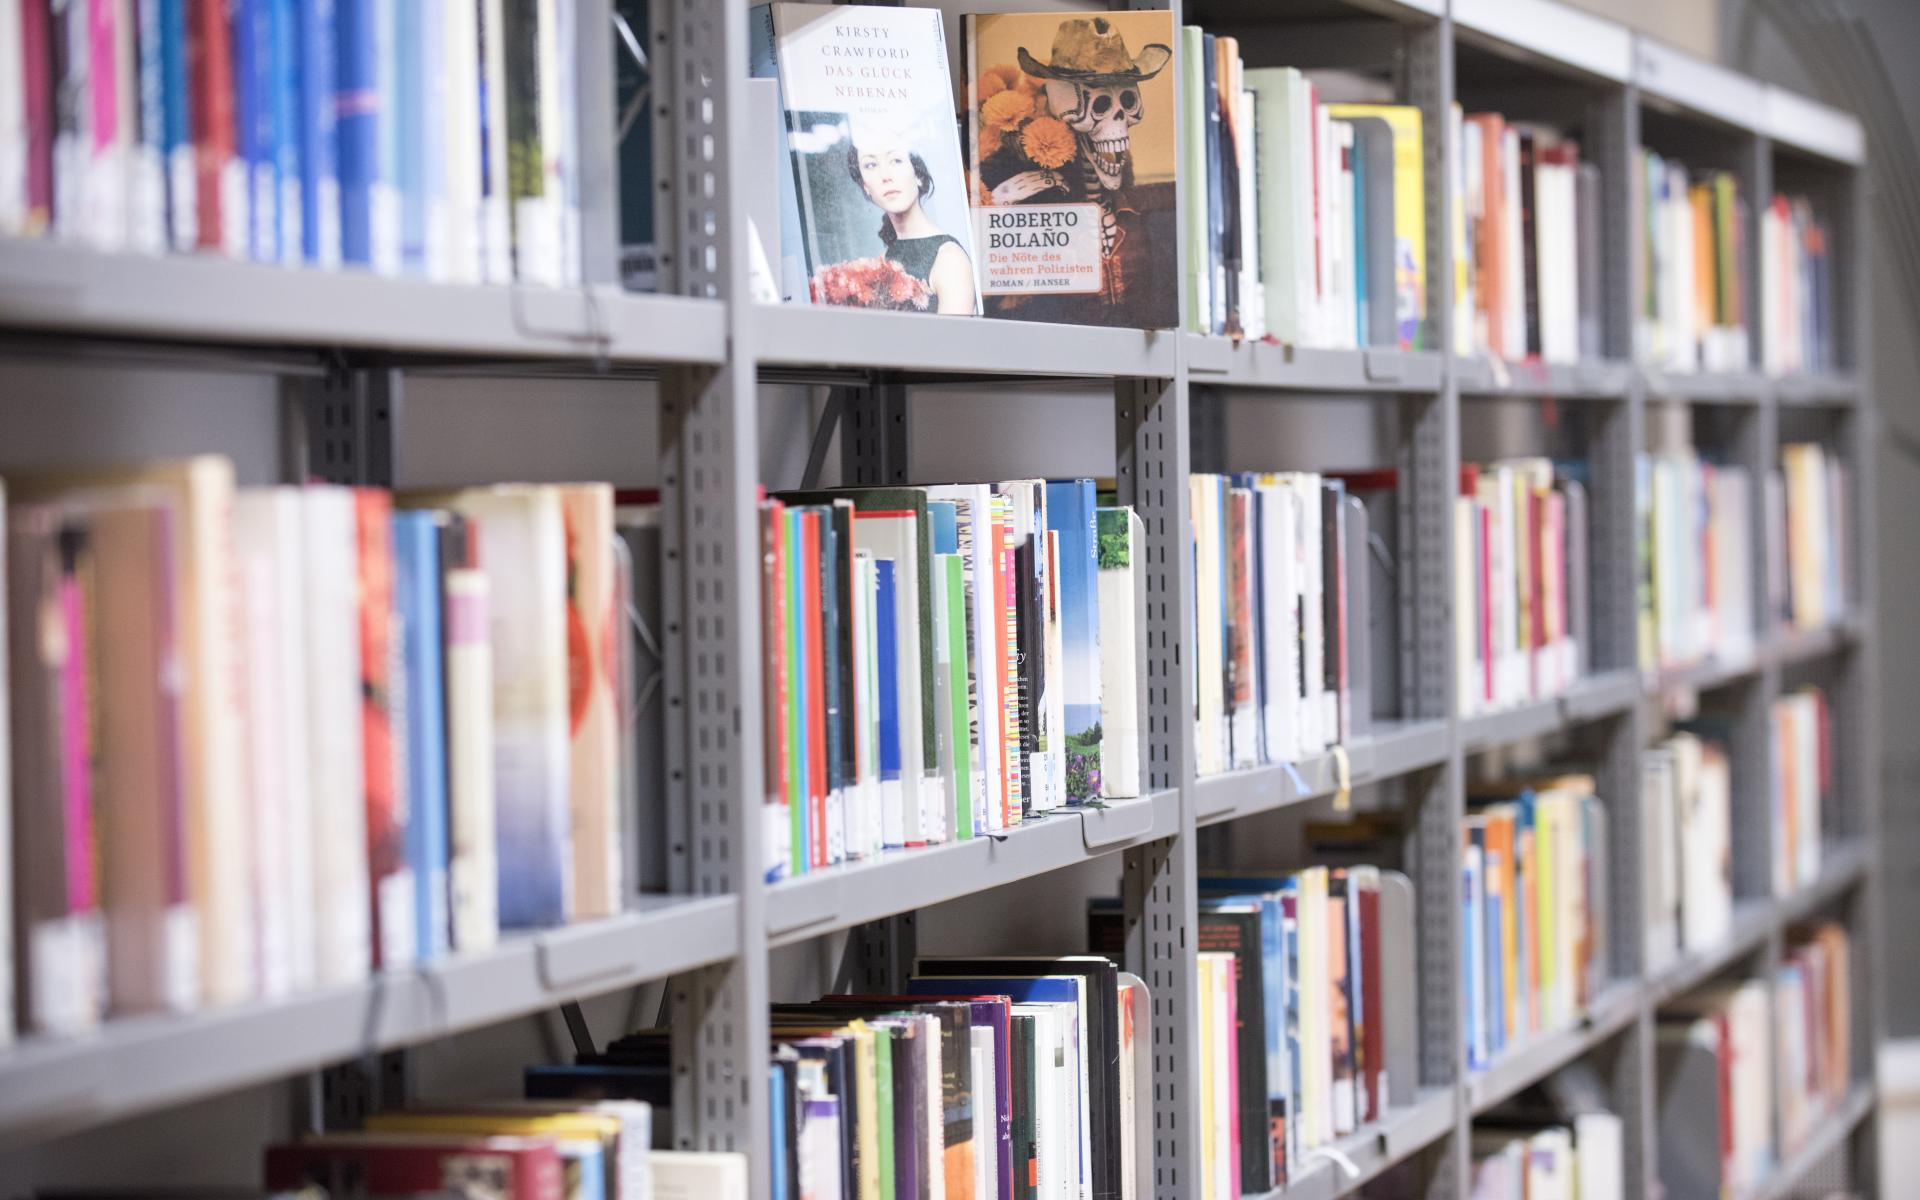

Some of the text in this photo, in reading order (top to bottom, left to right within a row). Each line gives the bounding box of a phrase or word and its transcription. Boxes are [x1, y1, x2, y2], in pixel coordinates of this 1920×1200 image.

[835, 26, 889, 38] KIRSTY
[821, 45, 909, 58] CRAWFORD
[825, 65, 853, 77] DAS
[835, 86, 907, 99] NEBENAN
[989, 212, 1078, 228] ROBERTO
[989, 229, 1070, 248] BOLAÑO
[989, 252, 1062, 263] Die Nöte des
[990, 263, 1094, 275] wahren Polizisten
[990, 279, 1024, 288] ROMAN
[1033, 279, 1070, 287] HANSER
[1089, 511, 1097, 559] Straße
